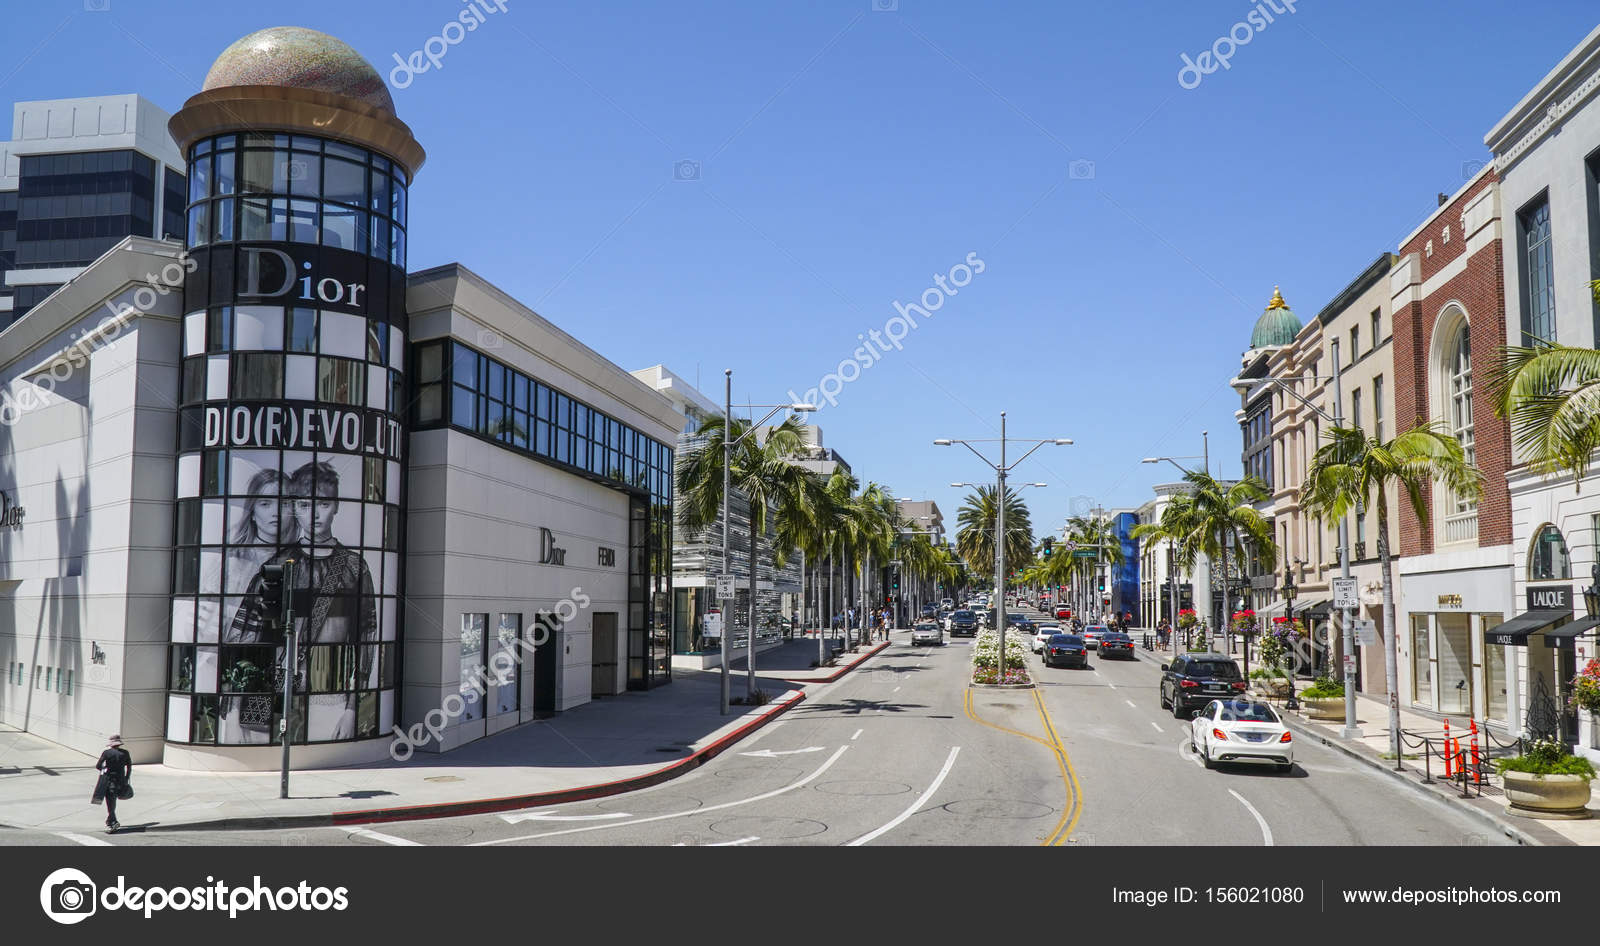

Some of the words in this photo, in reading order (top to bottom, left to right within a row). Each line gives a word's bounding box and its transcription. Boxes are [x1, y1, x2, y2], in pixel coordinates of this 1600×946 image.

[237, 247, 366, 307] Dior
[205, 405, 402, 459] DIO(R)EVOLUTI
[538, 526, 566, 566] Dior
[598, 546, 616, 567] FENDI
[1532, 591, 1565, 608] LALIQUE
